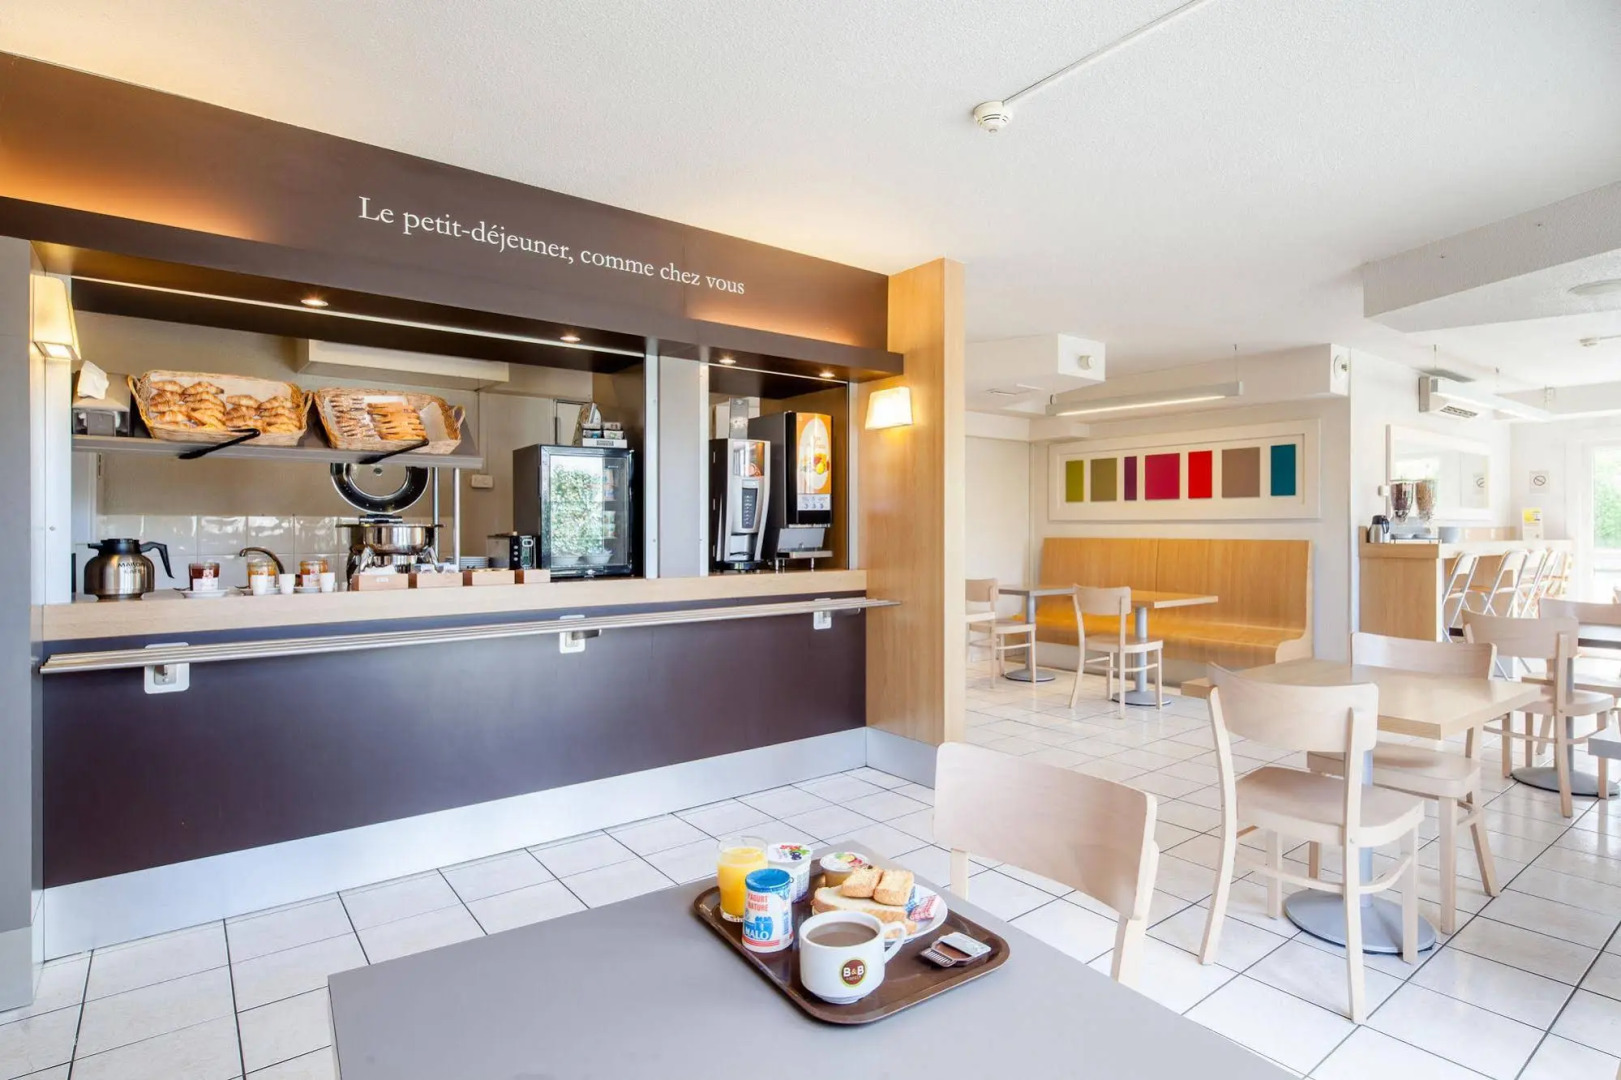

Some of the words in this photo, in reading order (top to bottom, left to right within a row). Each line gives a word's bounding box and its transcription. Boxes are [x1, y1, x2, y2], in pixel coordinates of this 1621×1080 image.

[358, 196, 394, 224] Le
[402, 211, 574, 264] petit-déjeuner,
[581, 249, 655, 277] comme
[660, 263, 701, 286] chez
[705, 275, 746, 296] vous
[745, 926, 769, 940] MALO
[843, 965, 864, 977] B&B
